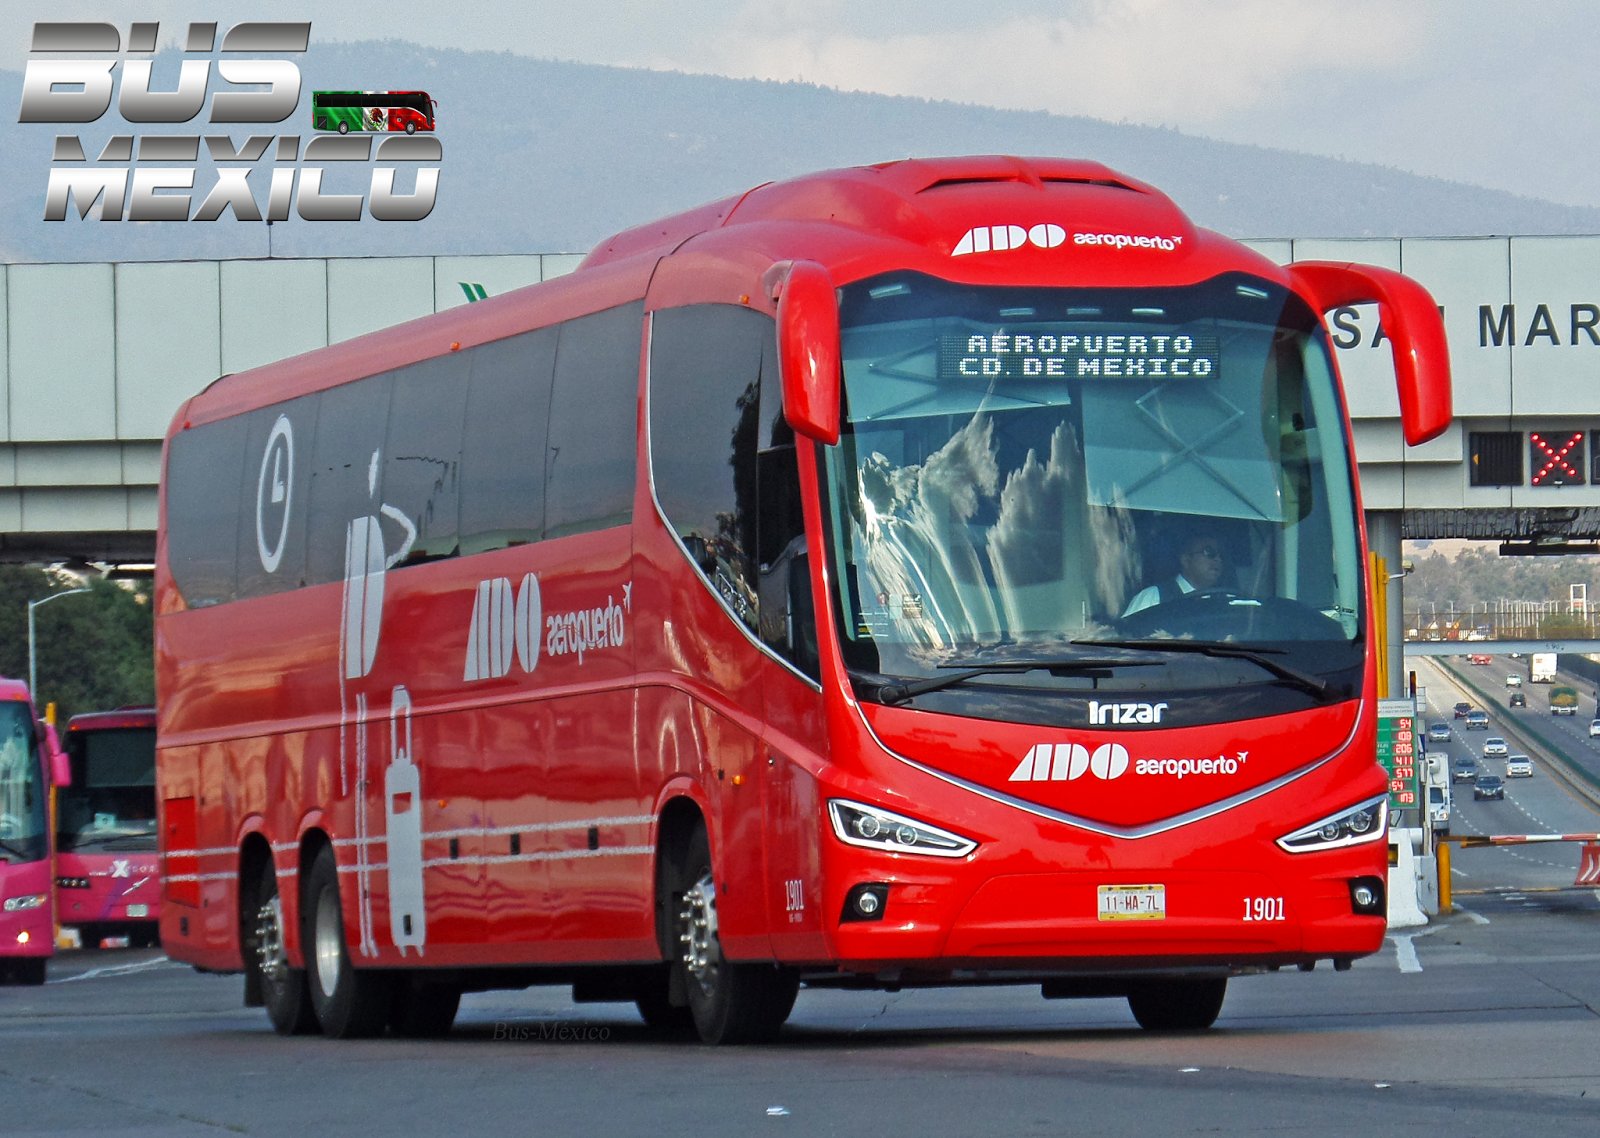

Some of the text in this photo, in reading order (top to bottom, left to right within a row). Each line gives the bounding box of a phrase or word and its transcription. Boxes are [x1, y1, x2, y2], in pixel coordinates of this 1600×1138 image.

[951, 223, 1175, 257] ADO aeropuerto
[1479, 303, 1600, 347] MAR
[968, 334, 1194, 354] AEROPUERTO
[959, 357, 1212, 376] CD. DE MEXICO
[463, 572, 625, 682] ADO aeropuerto
[1399, 718, 1412, 729] 54
[1395, 743, 1413, 754] 206
[1008, 743, 1238, 782] ADO aeropuerto
[1395, 755, 1413, 766] 411
[1395, 768, 1413, 778] 577
[785, 880, 804, 911] 1901
[1242, 897, 1286, 921] 1901
